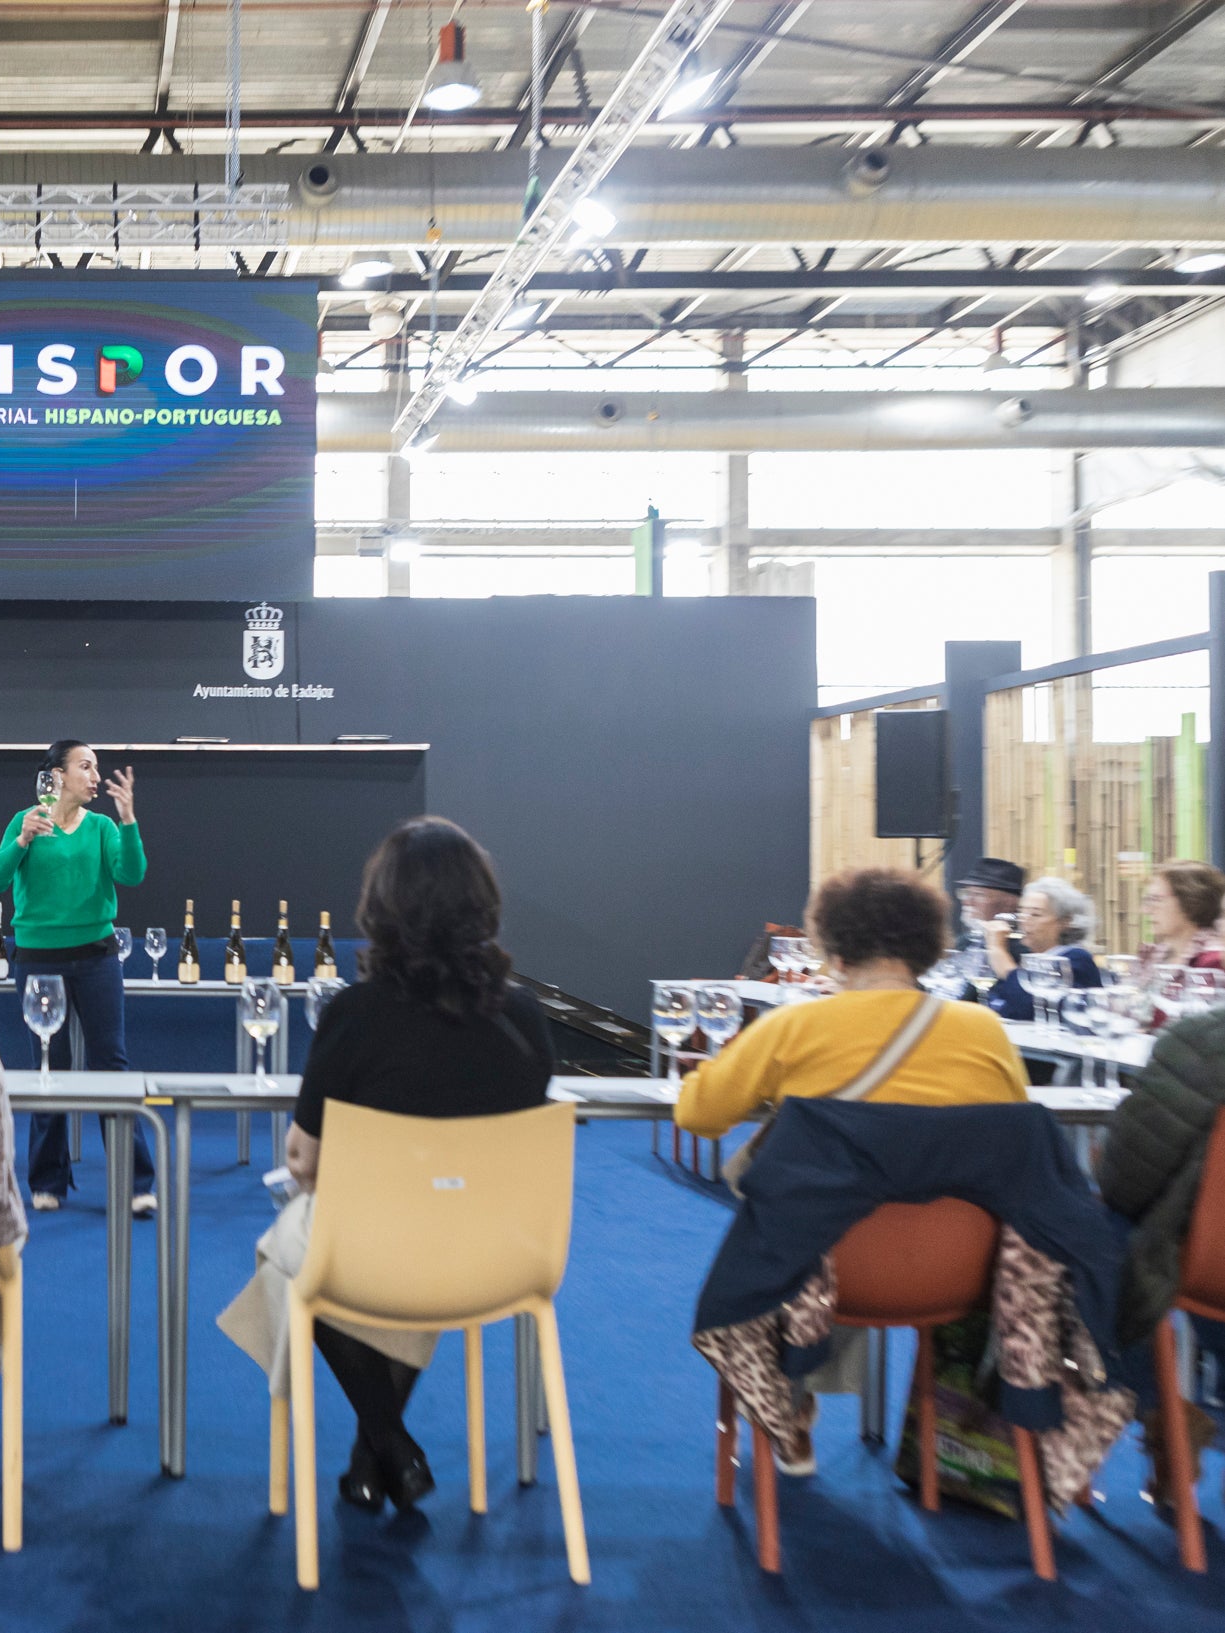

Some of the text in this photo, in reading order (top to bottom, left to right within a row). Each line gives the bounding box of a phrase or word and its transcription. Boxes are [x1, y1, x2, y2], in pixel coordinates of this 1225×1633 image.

[45, 408, 282, 426] HISPANO-PORTUGUESA
[193, 683, 272, 699] Ayuntamiento
[274, 683, 289, 698] de
